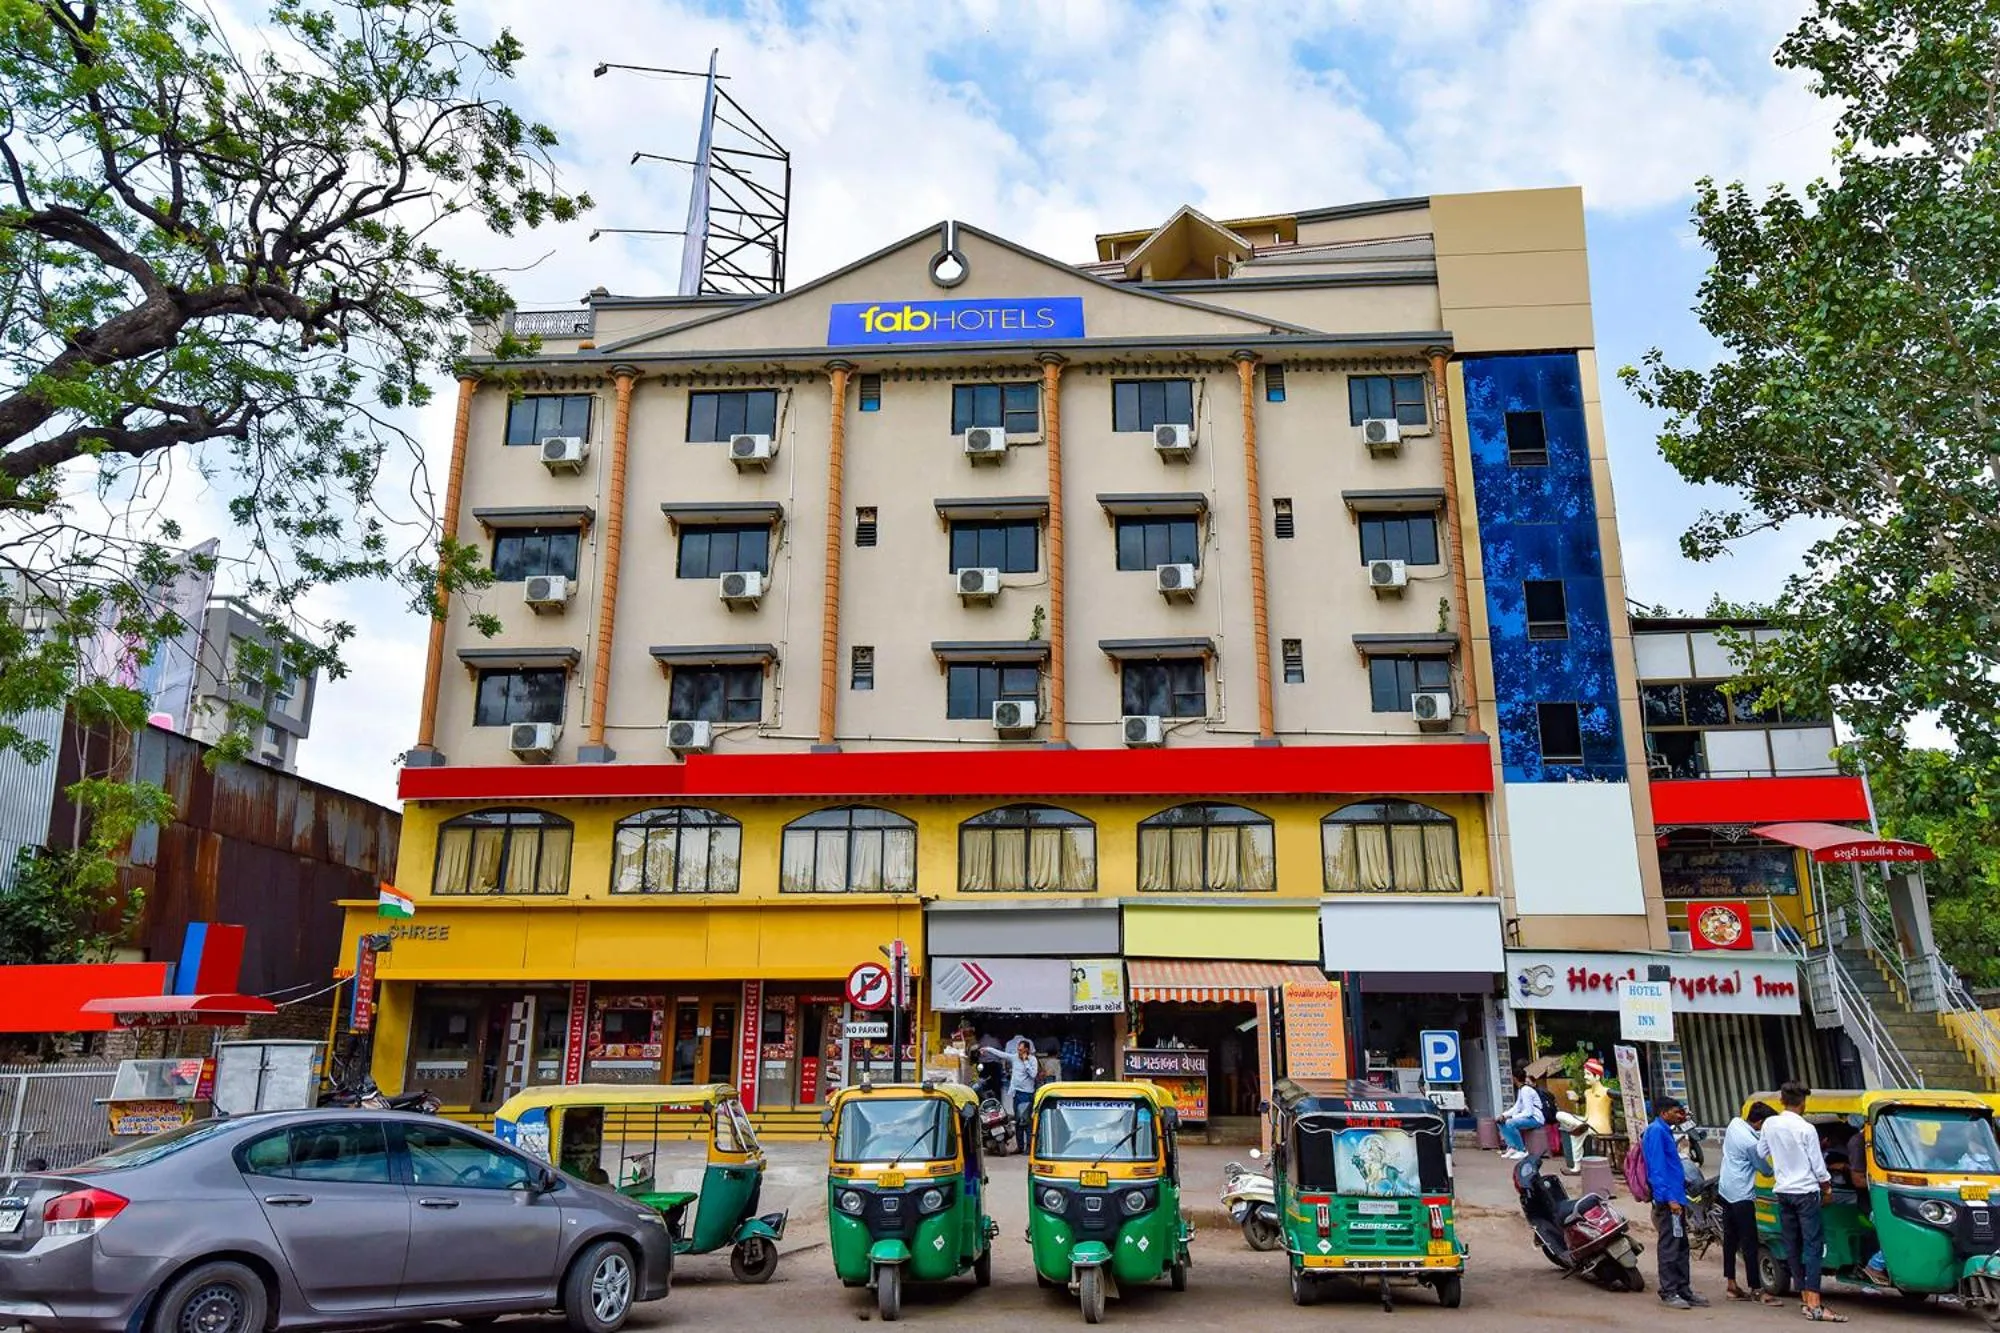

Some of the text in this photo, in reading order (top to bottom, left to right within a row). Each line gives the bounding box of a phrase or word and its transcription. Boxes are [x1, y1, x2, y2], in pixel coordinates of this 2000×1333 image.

[389, 925, 450, 940] SHREE
[1629, 985, 1662, 997] HOTEL
[1668, 969, 1741, 1001] rystal
[1753, 974, 1795, 997] Inn
[1638, 1015, 1655, 1026] INN
[1344, 1100, 1395, 1112] THAKOR
